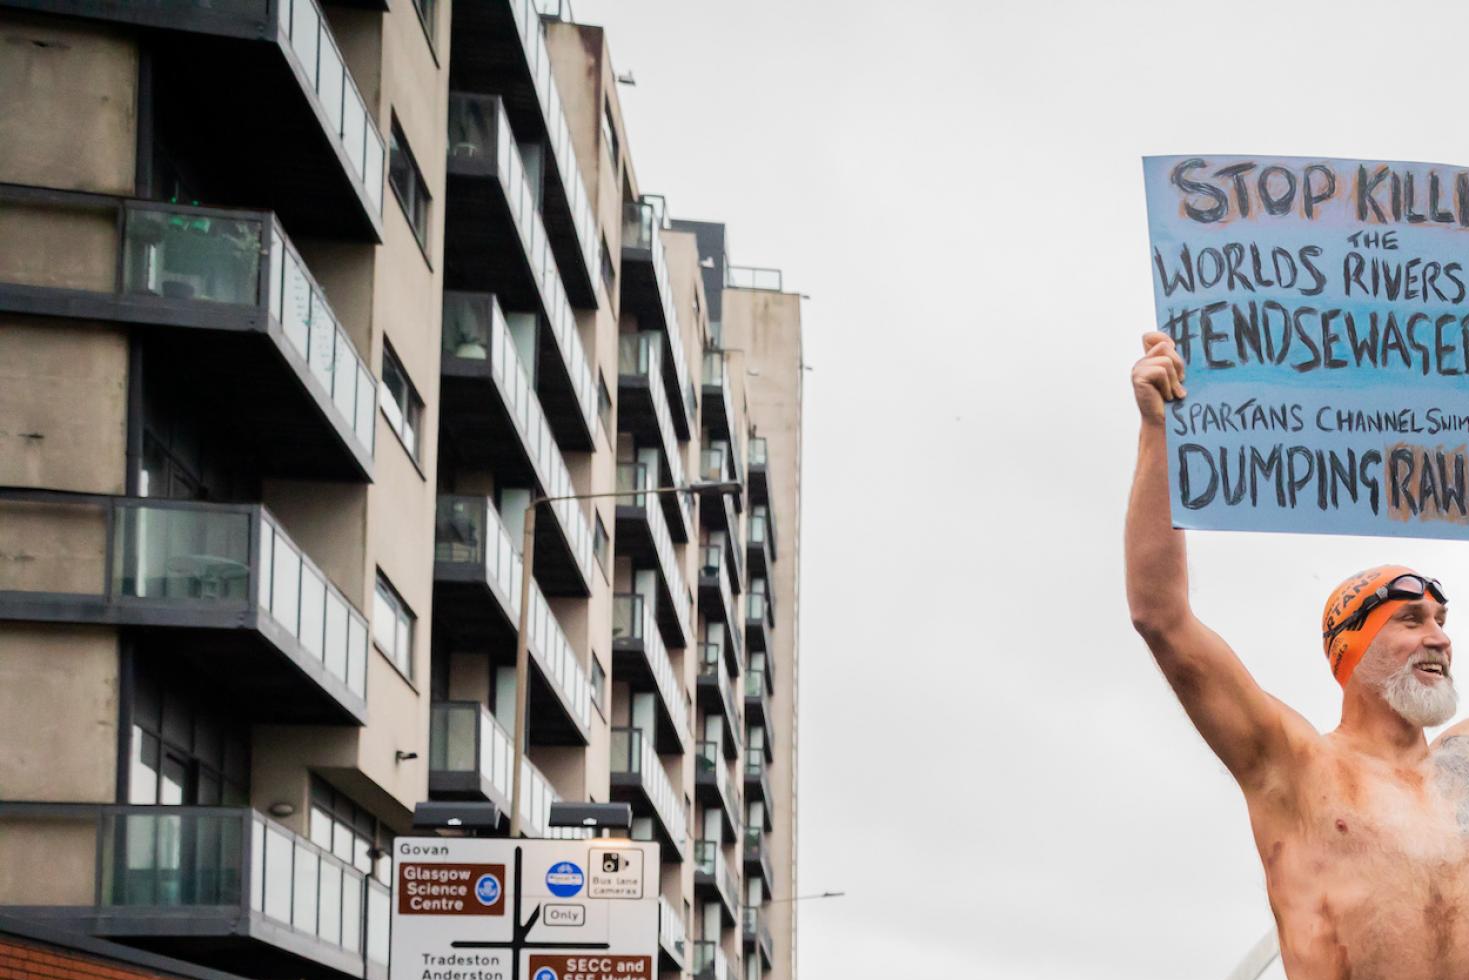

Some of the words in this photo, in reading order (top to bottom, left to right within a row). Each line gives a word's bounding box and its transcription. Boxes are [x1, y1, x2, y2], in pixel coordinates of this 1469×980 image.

[1171, 158, 1336, 225] STOP
[1347, 230, 1399, 251] THE
[1154, 242, 1327, 297] WORLDS
[1343, 251, 1466, 305] RIVERS
[1172, 398, 1304, 435] SPARTANS
[1316, 404, 1424, 434] CHANNEL
[1178, 444, 1380, 516] DUMPING
[1388, 447, 1468, 517] RAW
[400, 843, 449, 856] Govan
[404, 866, 471, 882] Glasgow
[407, 882, 467, 896] Science
[410, 896, 464, 911] Centre
[550, 910, 579, 922] Only
[422, 953, 500, 966] Tradeston
[566, 958, 612, 973] SECC
[616, 958, 645, 973] and
